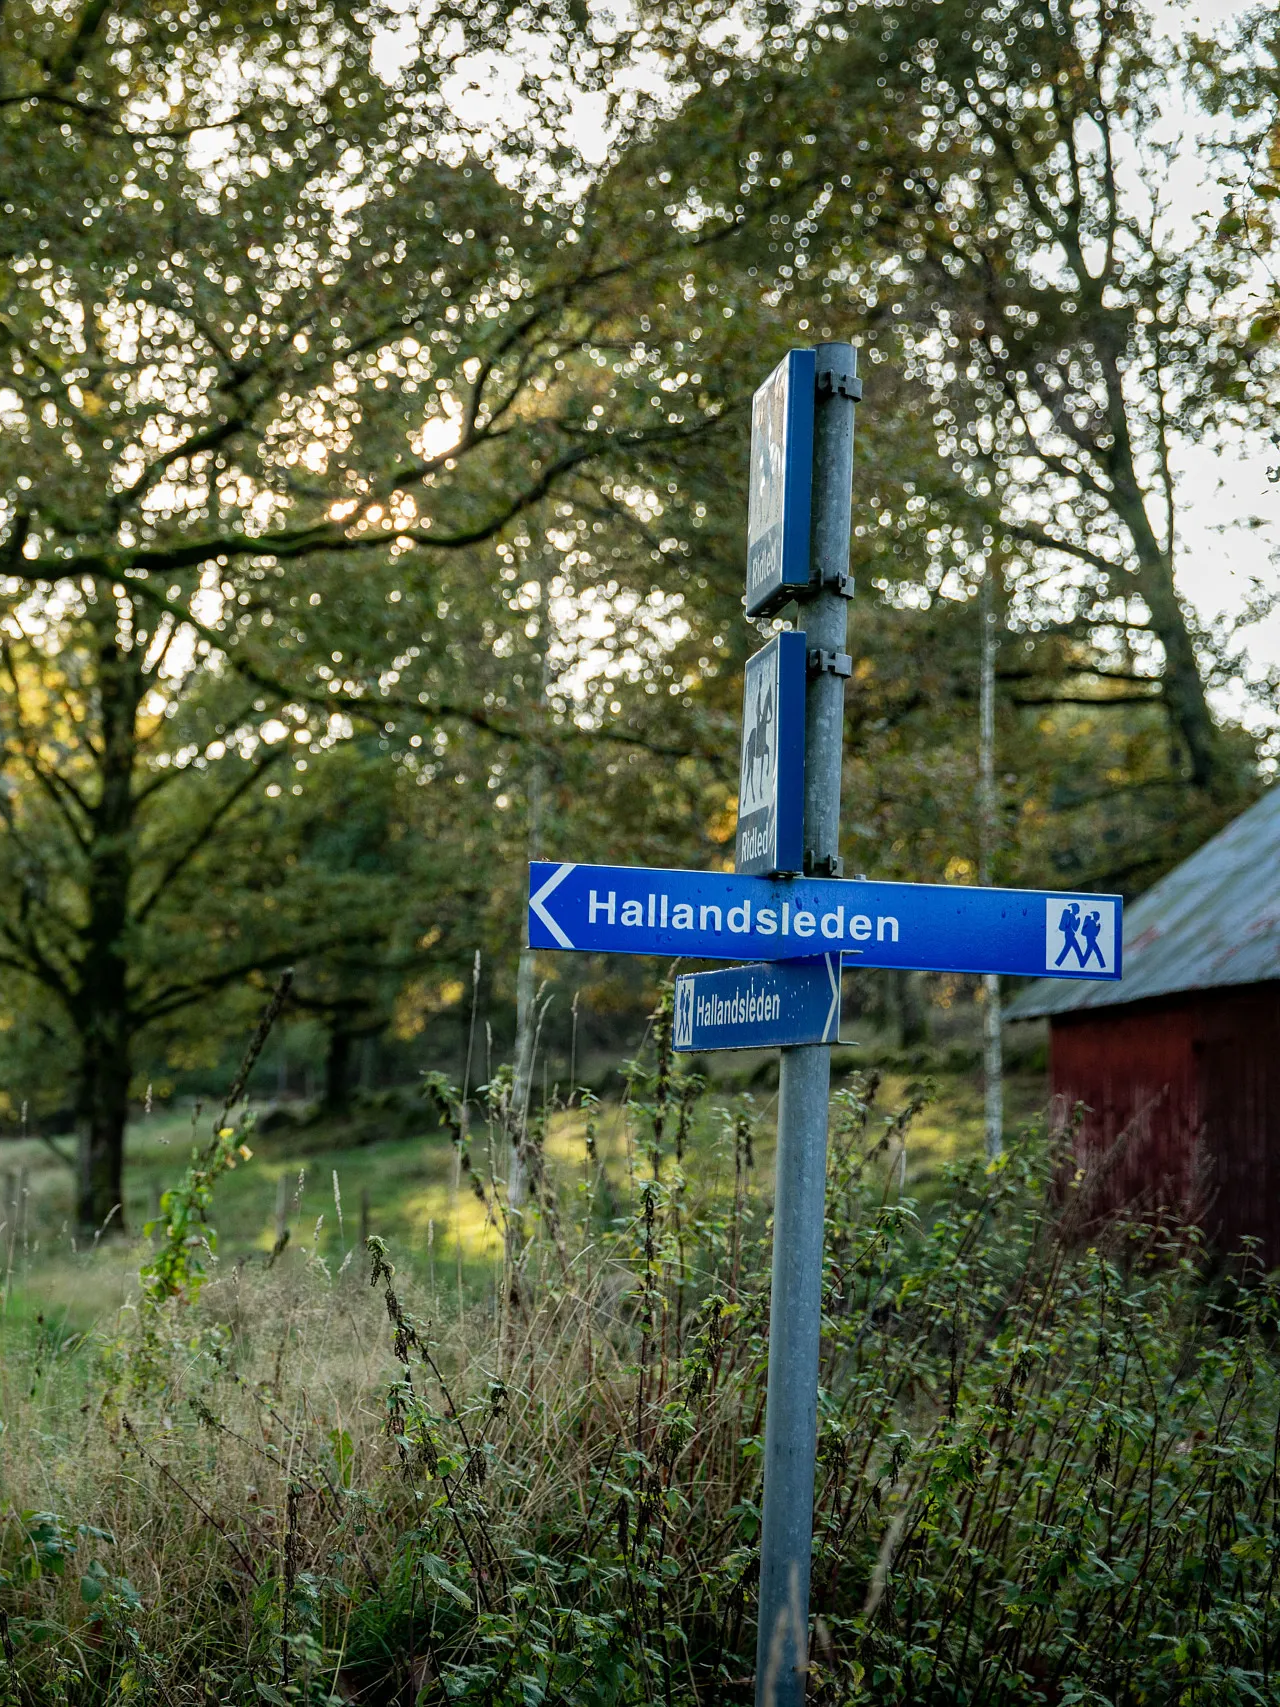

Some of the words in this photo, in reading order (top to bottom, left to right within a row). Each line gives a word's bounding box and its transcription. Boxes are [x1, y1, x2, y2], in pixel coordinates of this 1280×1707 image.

[741, 822, 769, 863] Ridled
[588, 889, 900, 942] Hallandsleden
[696, 988, 781, 1027] Hallandsleden
